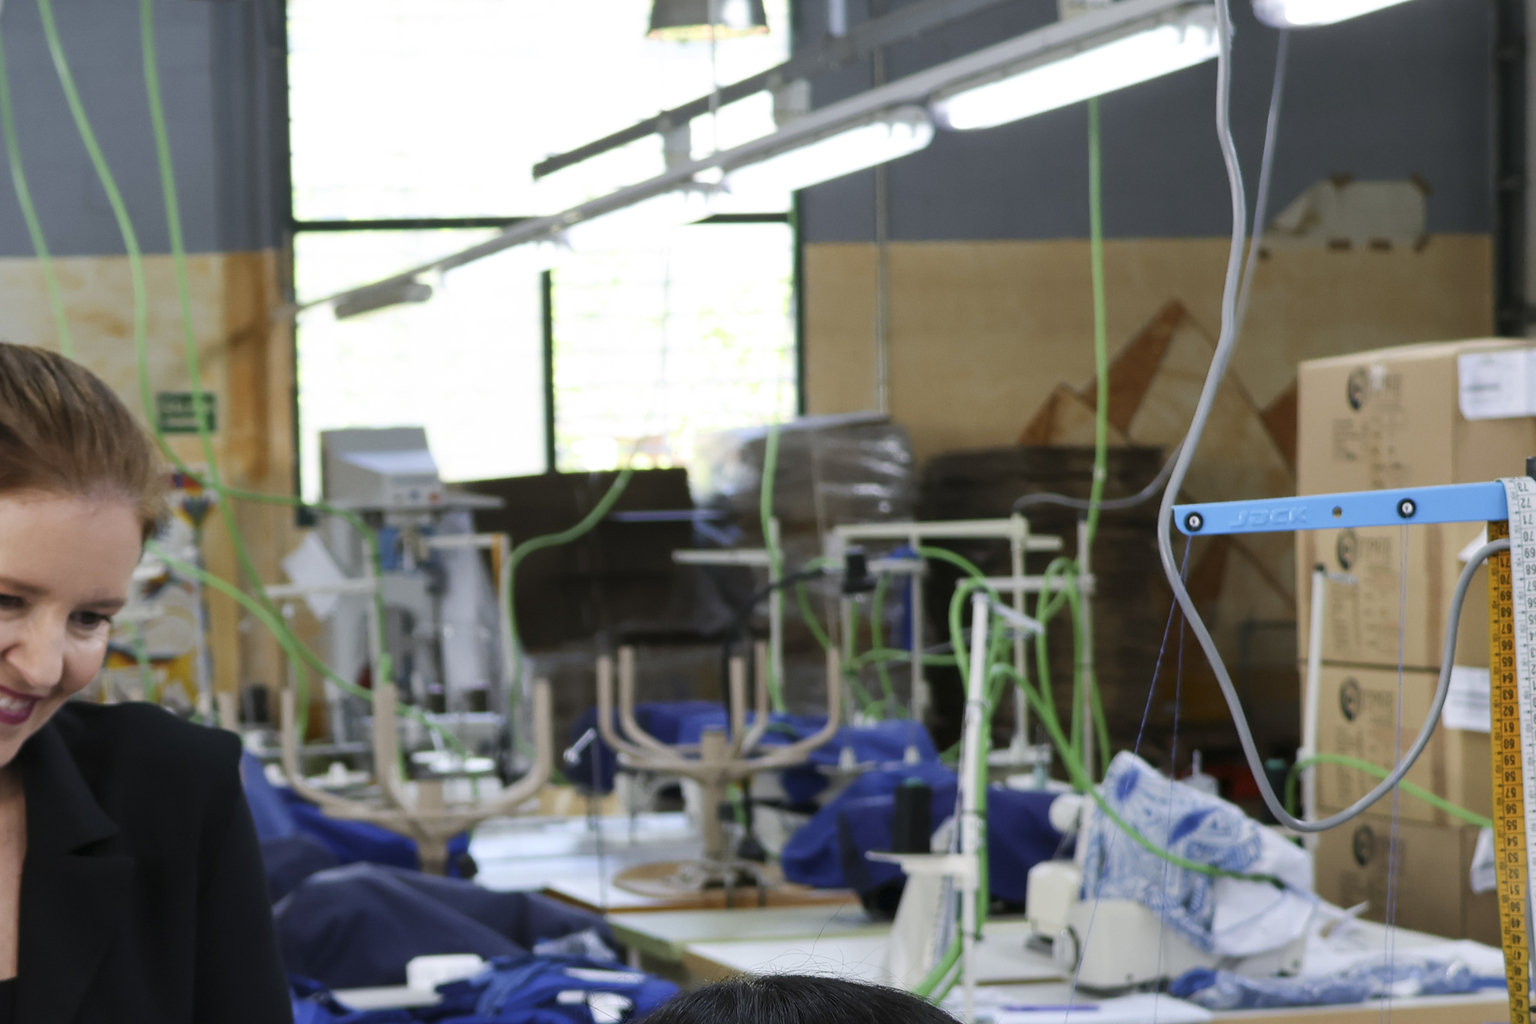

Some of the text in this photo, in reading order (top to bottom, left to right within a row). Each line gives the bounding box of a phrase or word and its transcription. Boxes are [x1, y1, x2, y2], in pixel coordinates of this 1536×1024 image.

[1520, 497, 1532, 508] 72
[1523, 514, 1533, 525] 71
[1524, 530, 1535, 541] 70
[1524, 547, 1536, 558] 69
[1500, 590, 1512, 601] 69
[1500, 607, 1512, 618] 68
[1501, 623, 1512, 634] 67
[1502, 640, 1513, 651] 66
[1502, 656, 1513, 667] 65
[1502, 672, 1514, 683] 64
[1503, 689, 1514, 700] 63
[1503, 705, 1514, 716] 62
[1504, 722, 1515, 733] 61
[1504, 738, 1515, 749] 60
[1504, 755, 1515, 765] 59
[1505, 771, 1516, 782] 58
[1505, 787, 1517, 798] 57
[1506, 803, 1517, 814] 56
[1506, 820, 1517, 830] 55
[1507, 836, 1518, 846] 54
[1508, 852, 1518, 863] 53
[1508, 868, 1519, 879] 52
[1509, 884, 1520, 895] 51
[1510, 901, 1521, 912] 50
